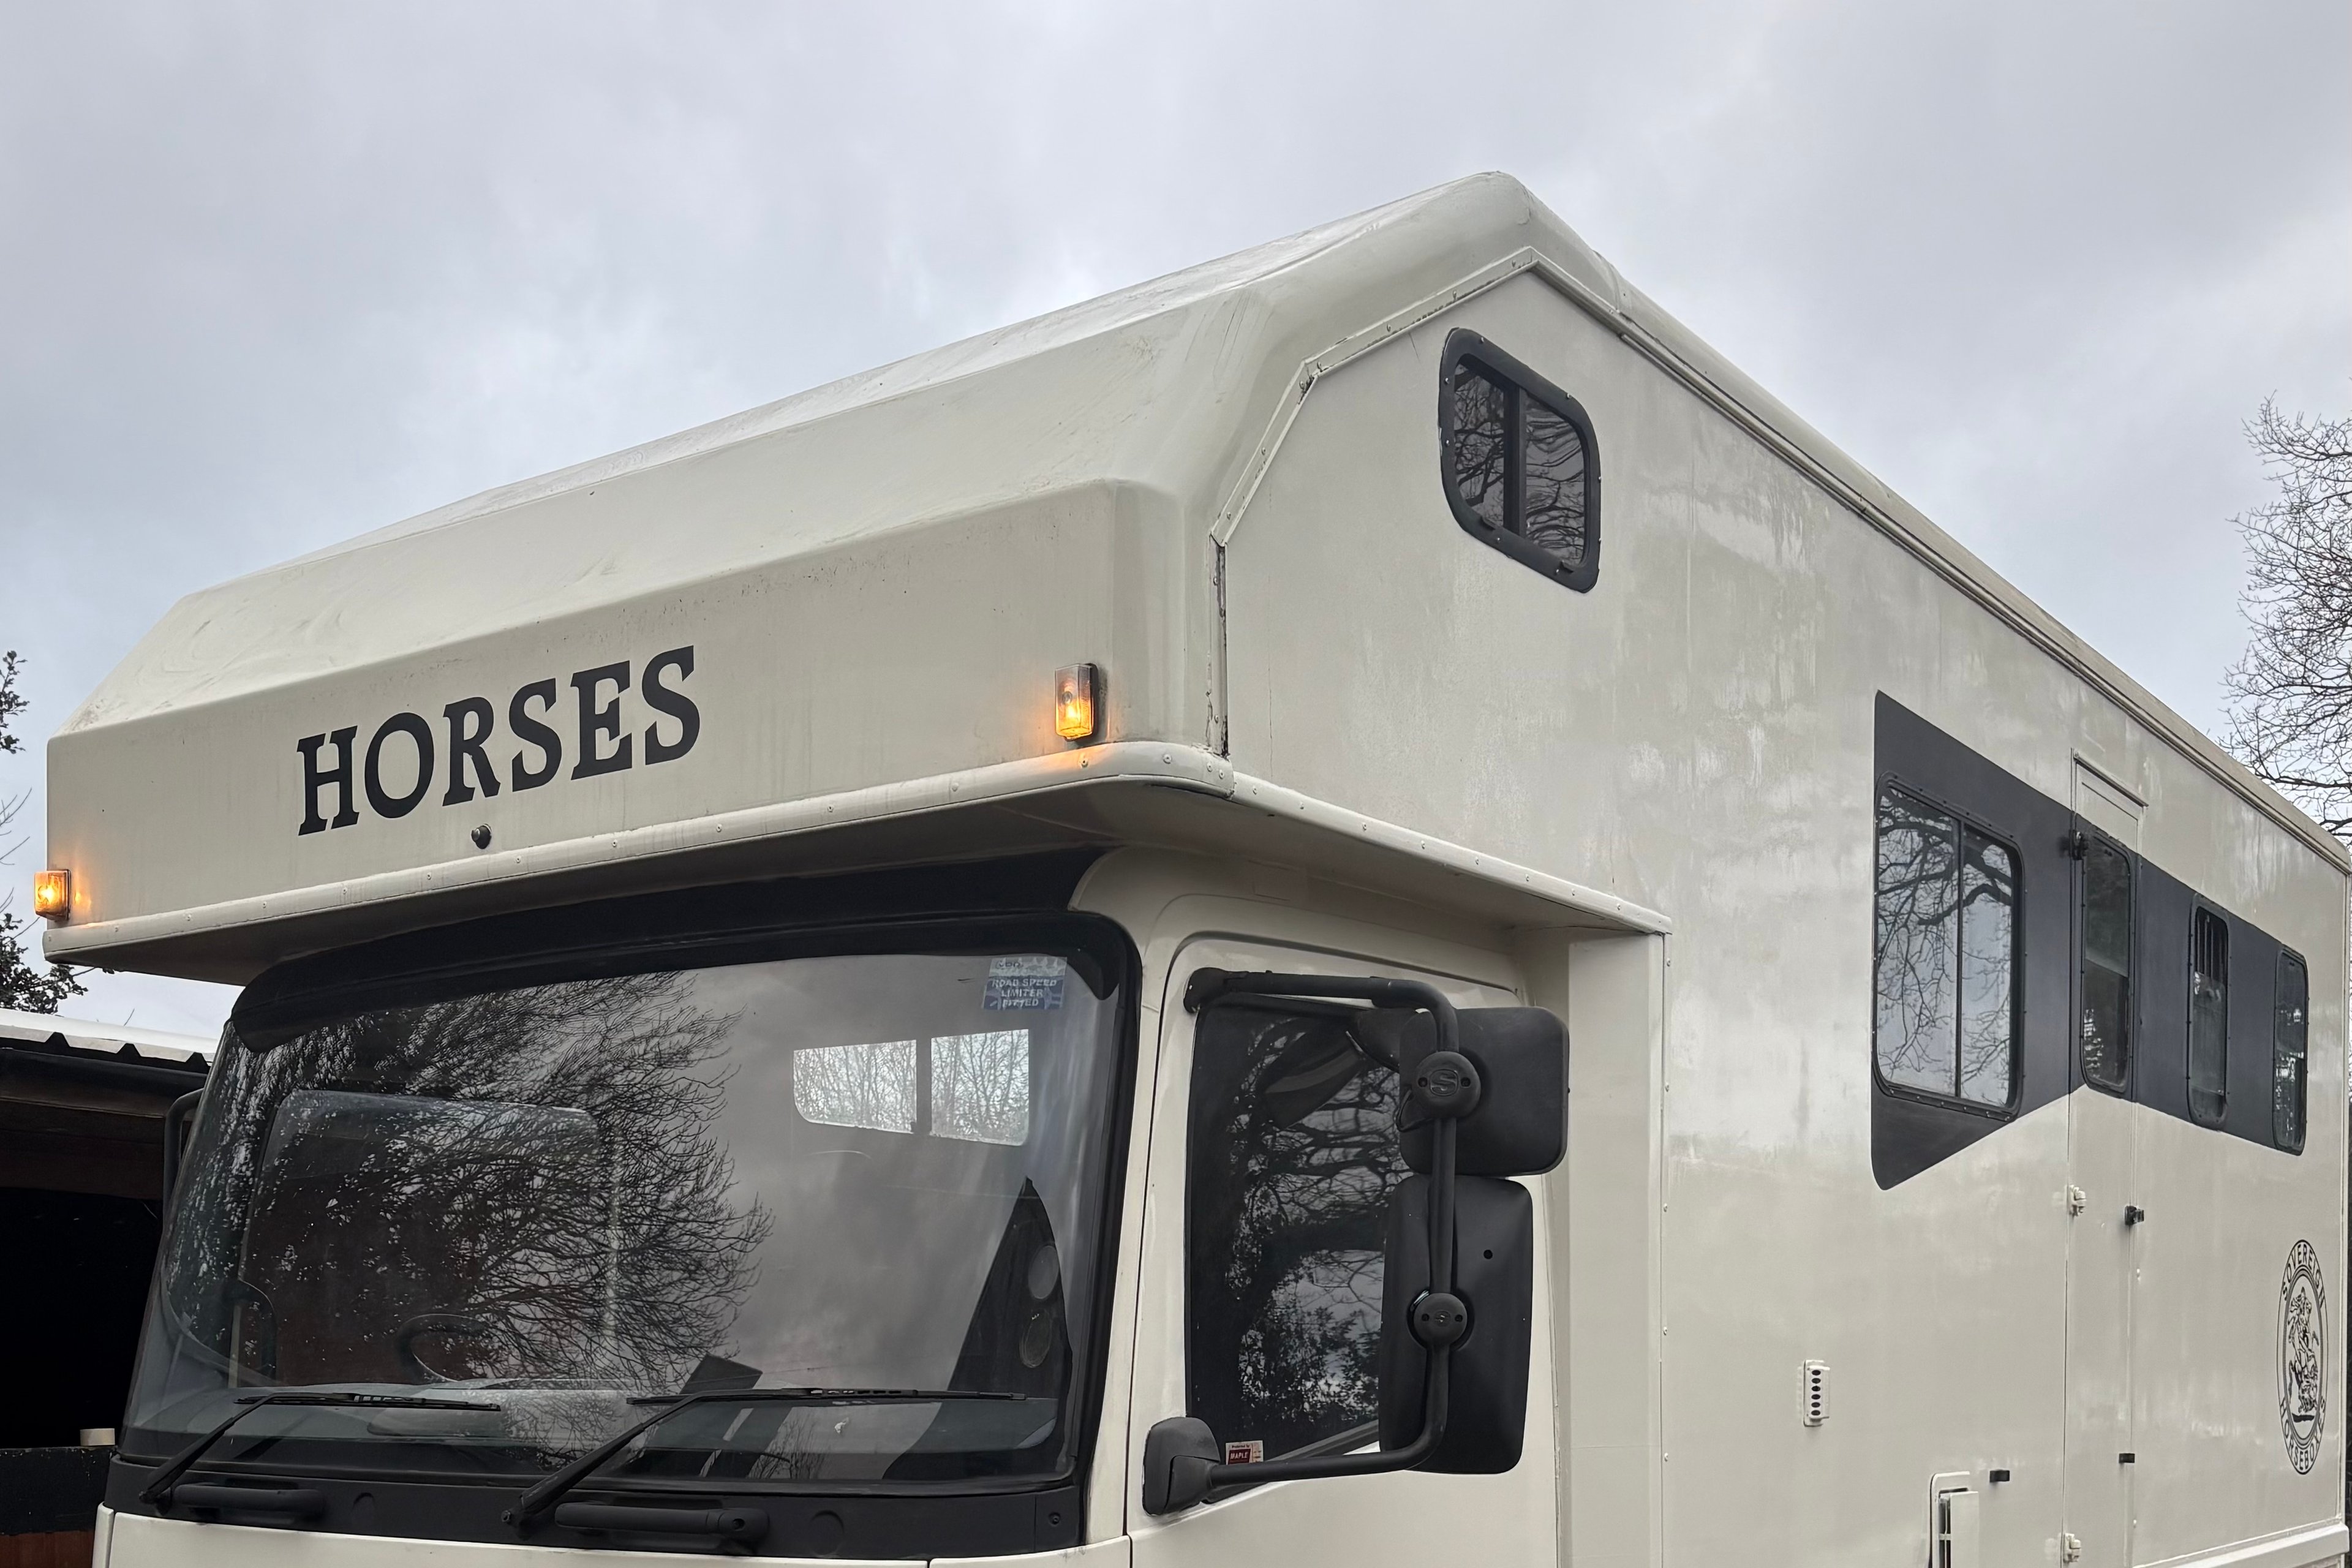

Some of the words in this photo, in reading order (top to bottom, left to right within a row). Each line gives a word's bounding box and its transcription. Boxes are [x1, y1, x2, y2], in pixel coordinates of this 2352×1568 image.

[297, 645, 700, 835] HORSES
[992, 979, 1019, 987] ROAD
[1001, 988, 1044, 997] LIMITER
[2282, 1243, 2326, 1309] SOVEREIGN
[2280, 1395, 2326, 1471] HORSEBOXES
